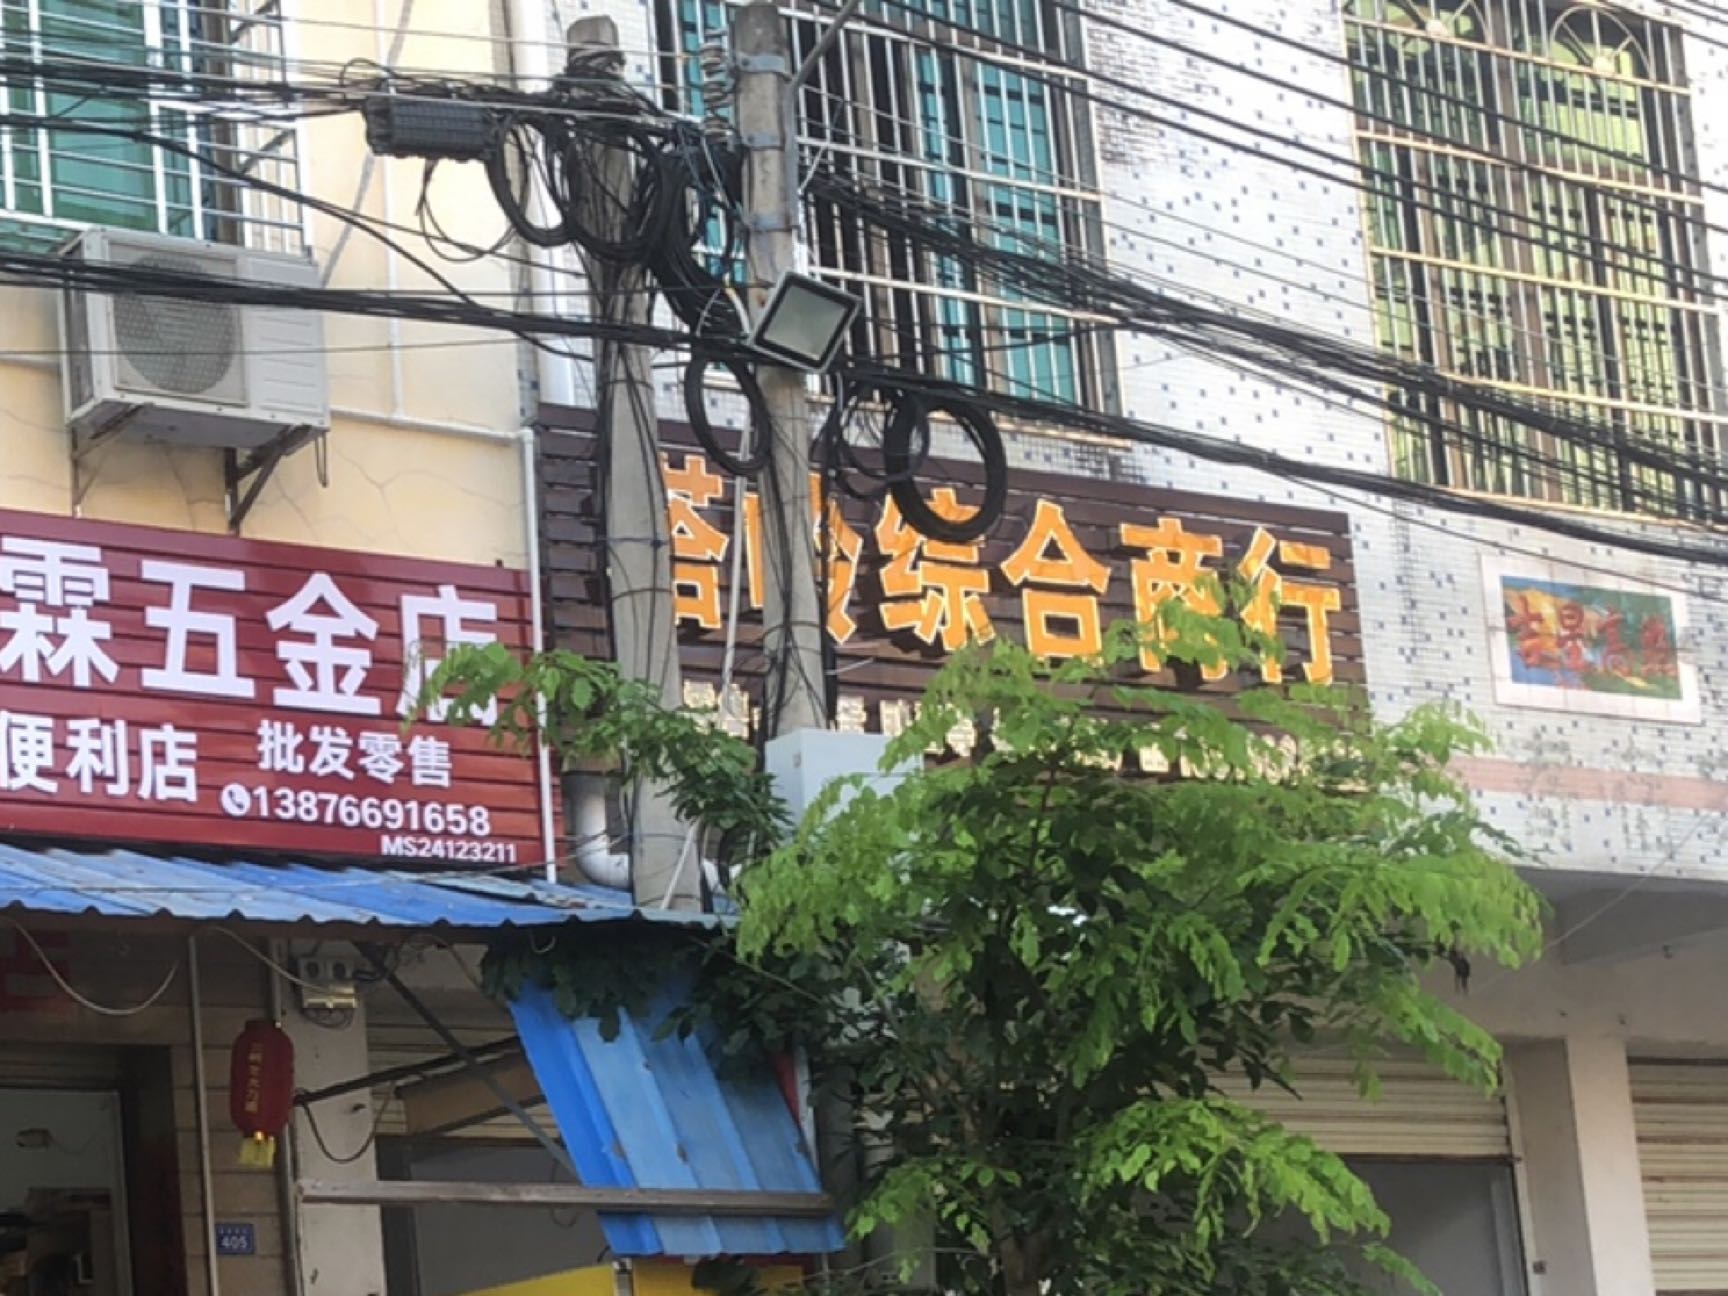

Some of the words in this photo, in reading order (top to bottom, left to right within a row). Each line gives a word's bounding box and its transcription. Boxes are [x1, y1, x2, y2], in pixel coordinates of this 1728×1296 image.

[257, 718, 453, 788] 批发零售
[253, 785, 491, 836] 13876691658
[380, 836, 517, 864] MS24123211
